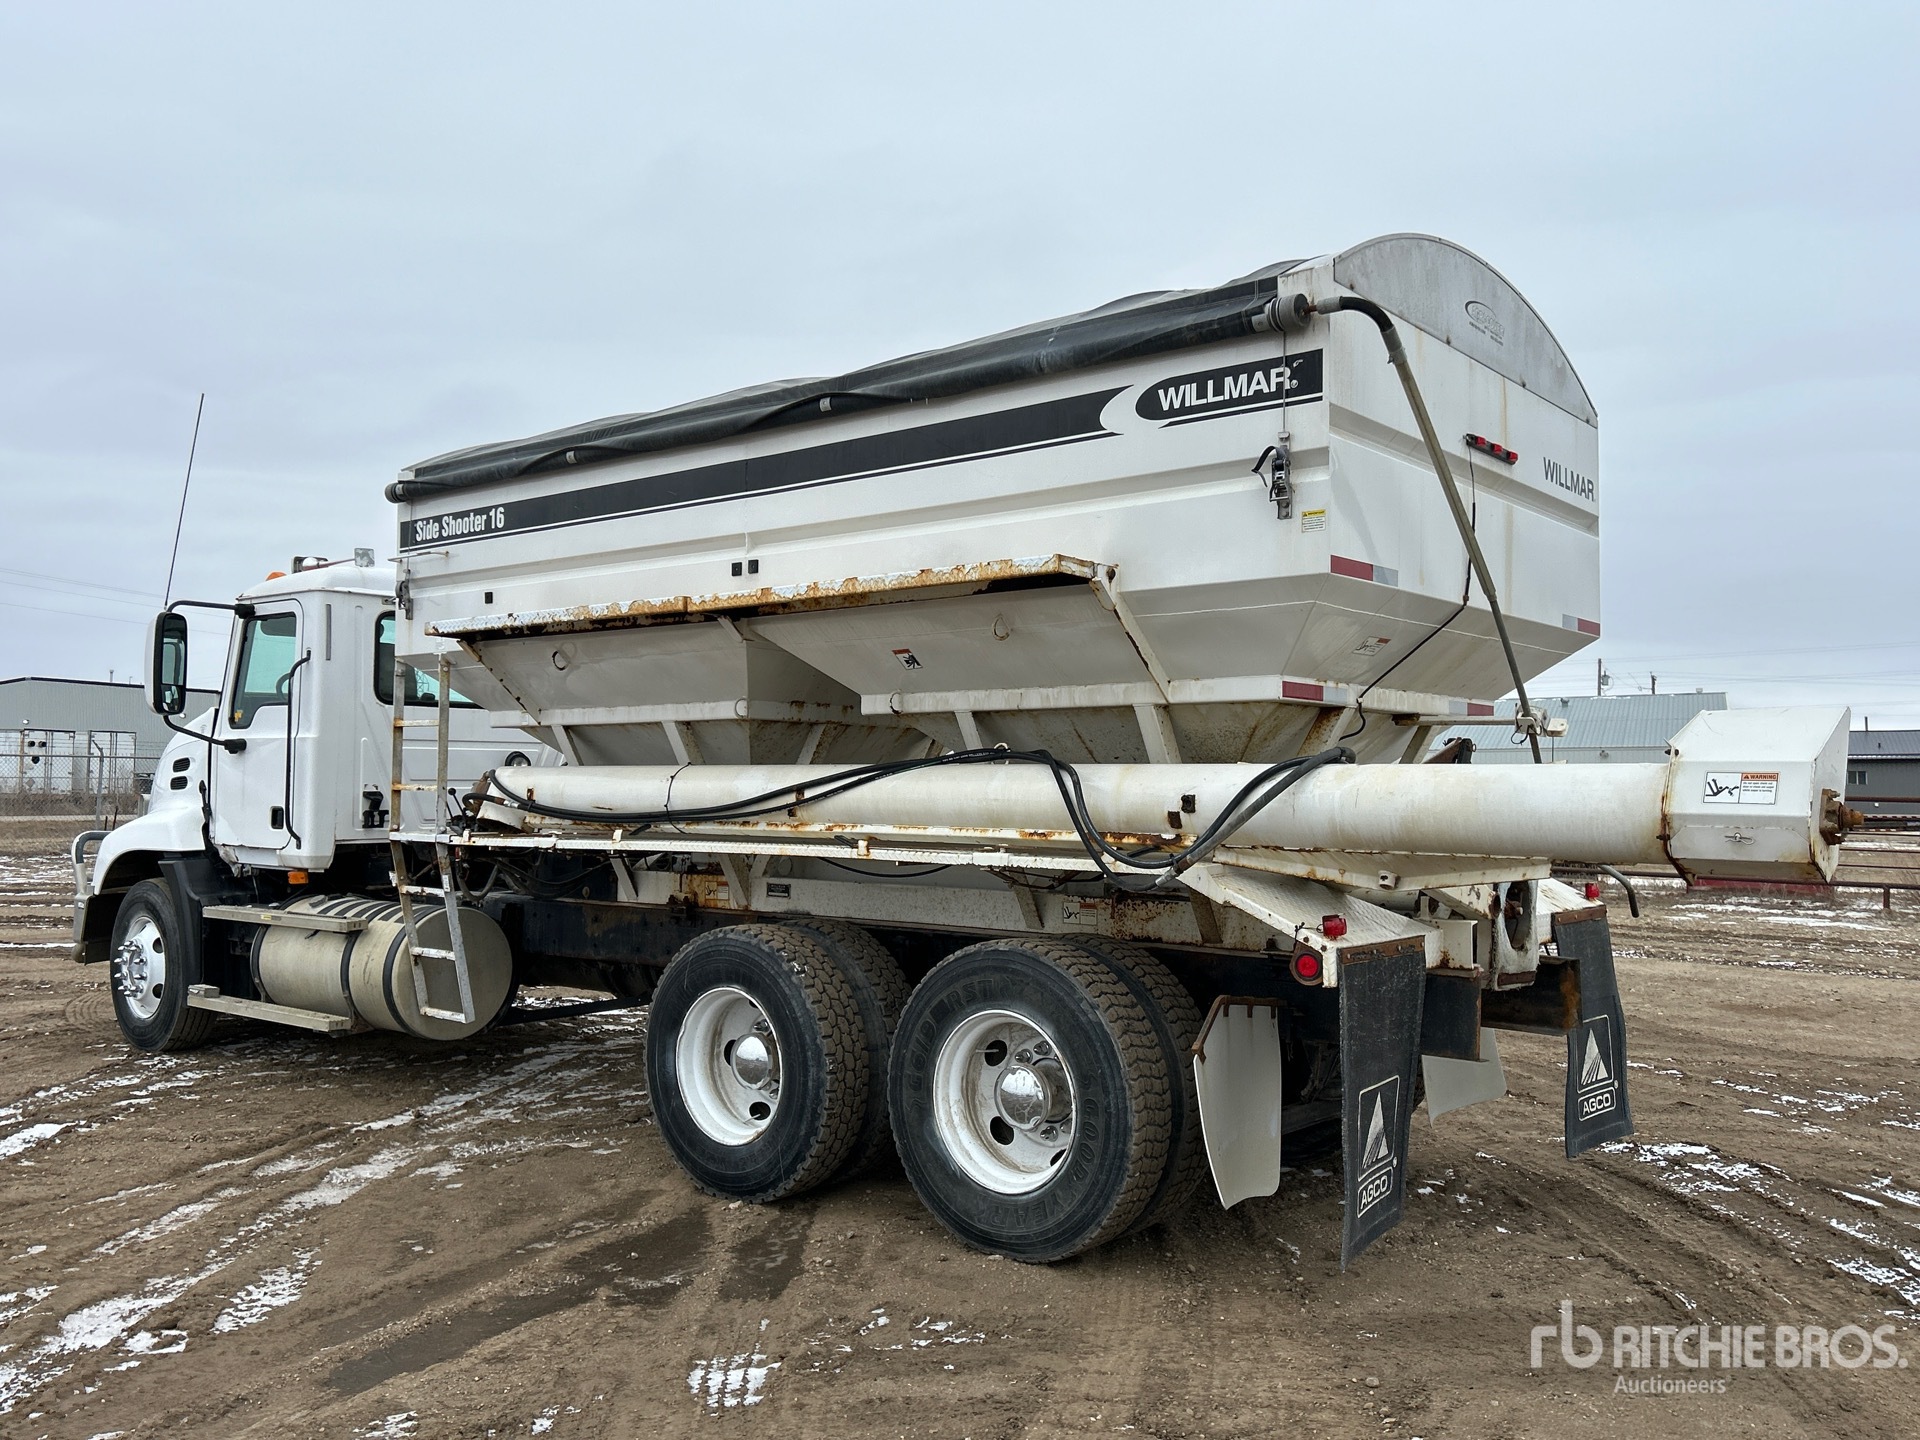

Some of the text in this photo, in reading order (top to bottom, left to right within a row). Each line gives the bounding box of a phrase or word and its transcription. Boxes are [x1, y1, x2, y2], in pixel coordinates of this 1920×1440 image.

[1157, 367, 1292, 412] WILLMAR
[1543, 456, 1595, 502] WILLMAR
[415, 506, 505, 542] Side Shooter 16
[1582, 1093, 1611, 1116] AGCO
[1360, 1175, 1388, 1210] AGCO
